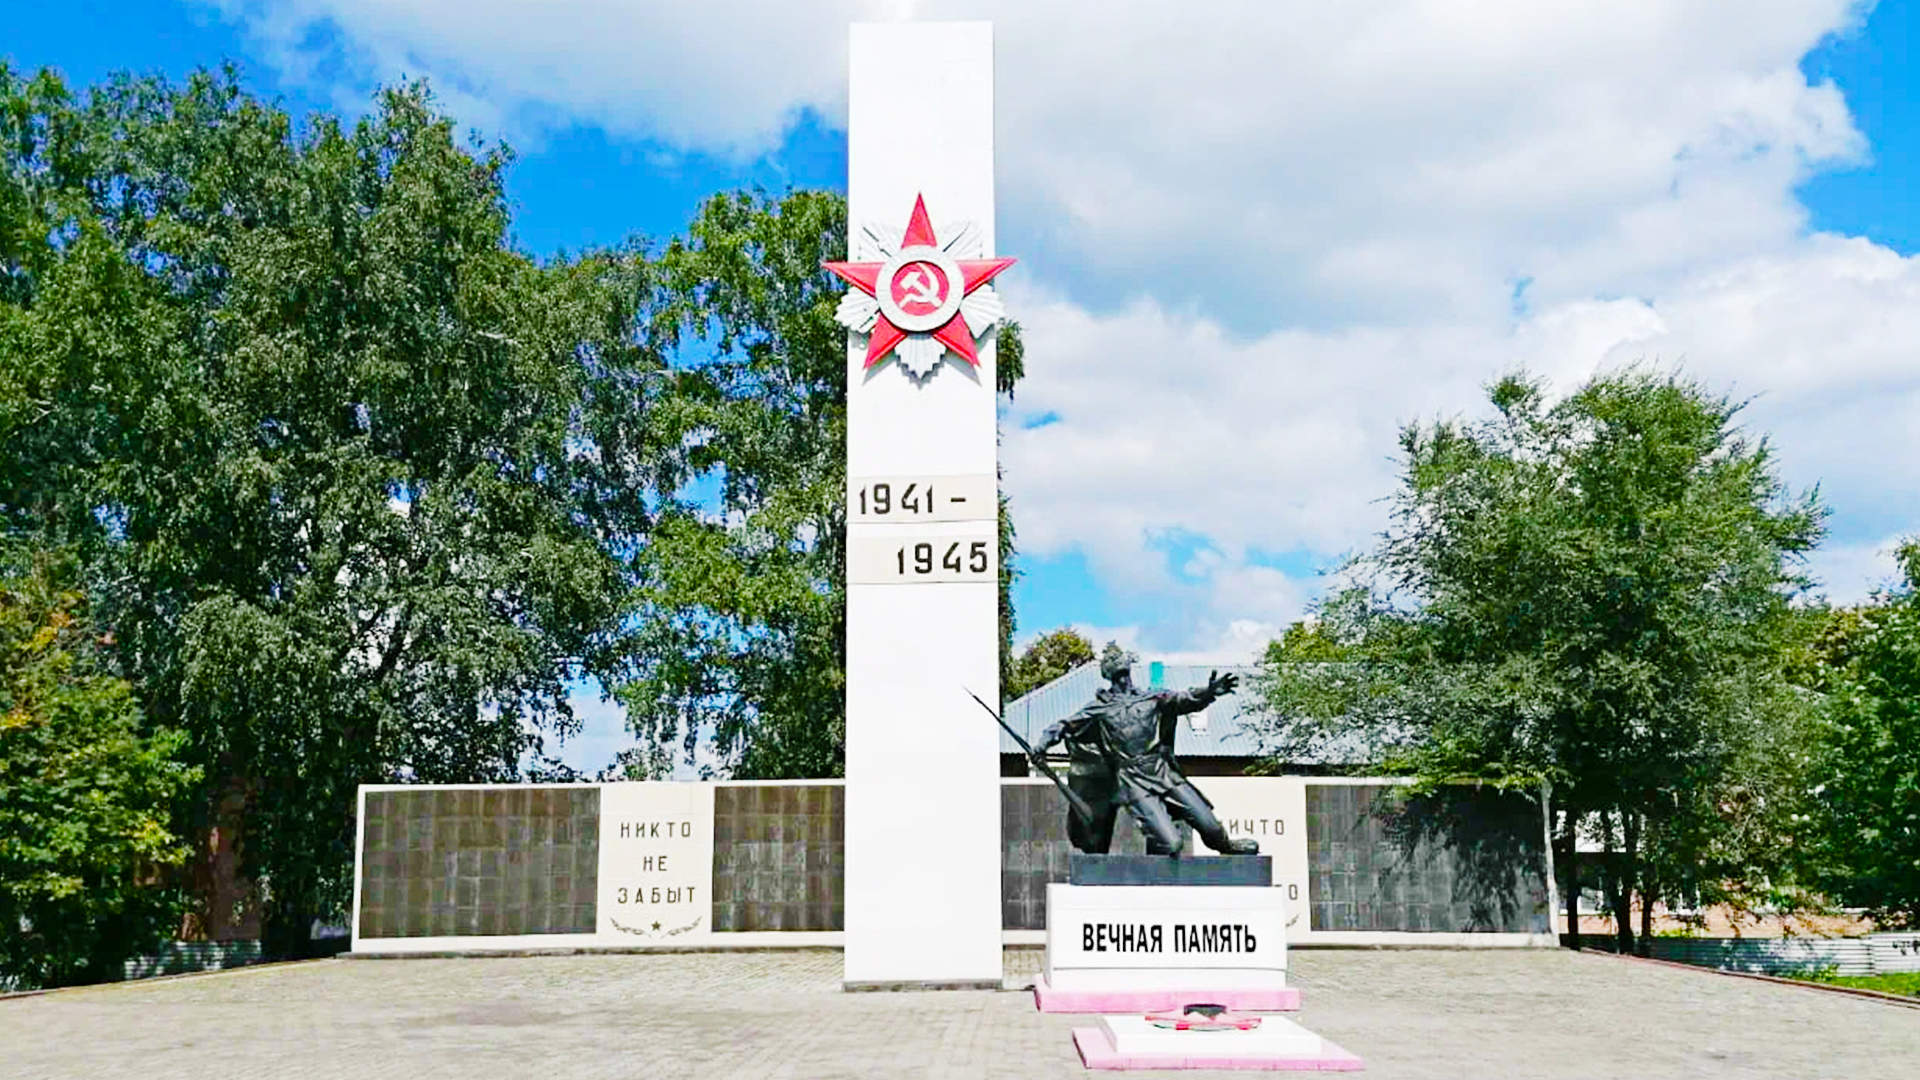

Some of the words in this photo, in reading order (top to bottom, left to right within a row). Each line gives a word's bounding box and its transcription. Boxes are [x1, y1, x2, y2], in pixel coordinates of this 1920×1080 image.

[859, 483, 933, 515] 1941
[897, 541, 988, 575] 1945
[620, 821, 691, 838] НИКТО
[1219, 818, 1285, 836] ИЧТО
[643, 855, 668, 872] НЕ
[617, 886, 696, 905] ЗАБЫТ
[1082, 923, 1163, 953] ВЕЧНАЯ
[1174, 924, 1257, 953] ПАМЯТЬ
